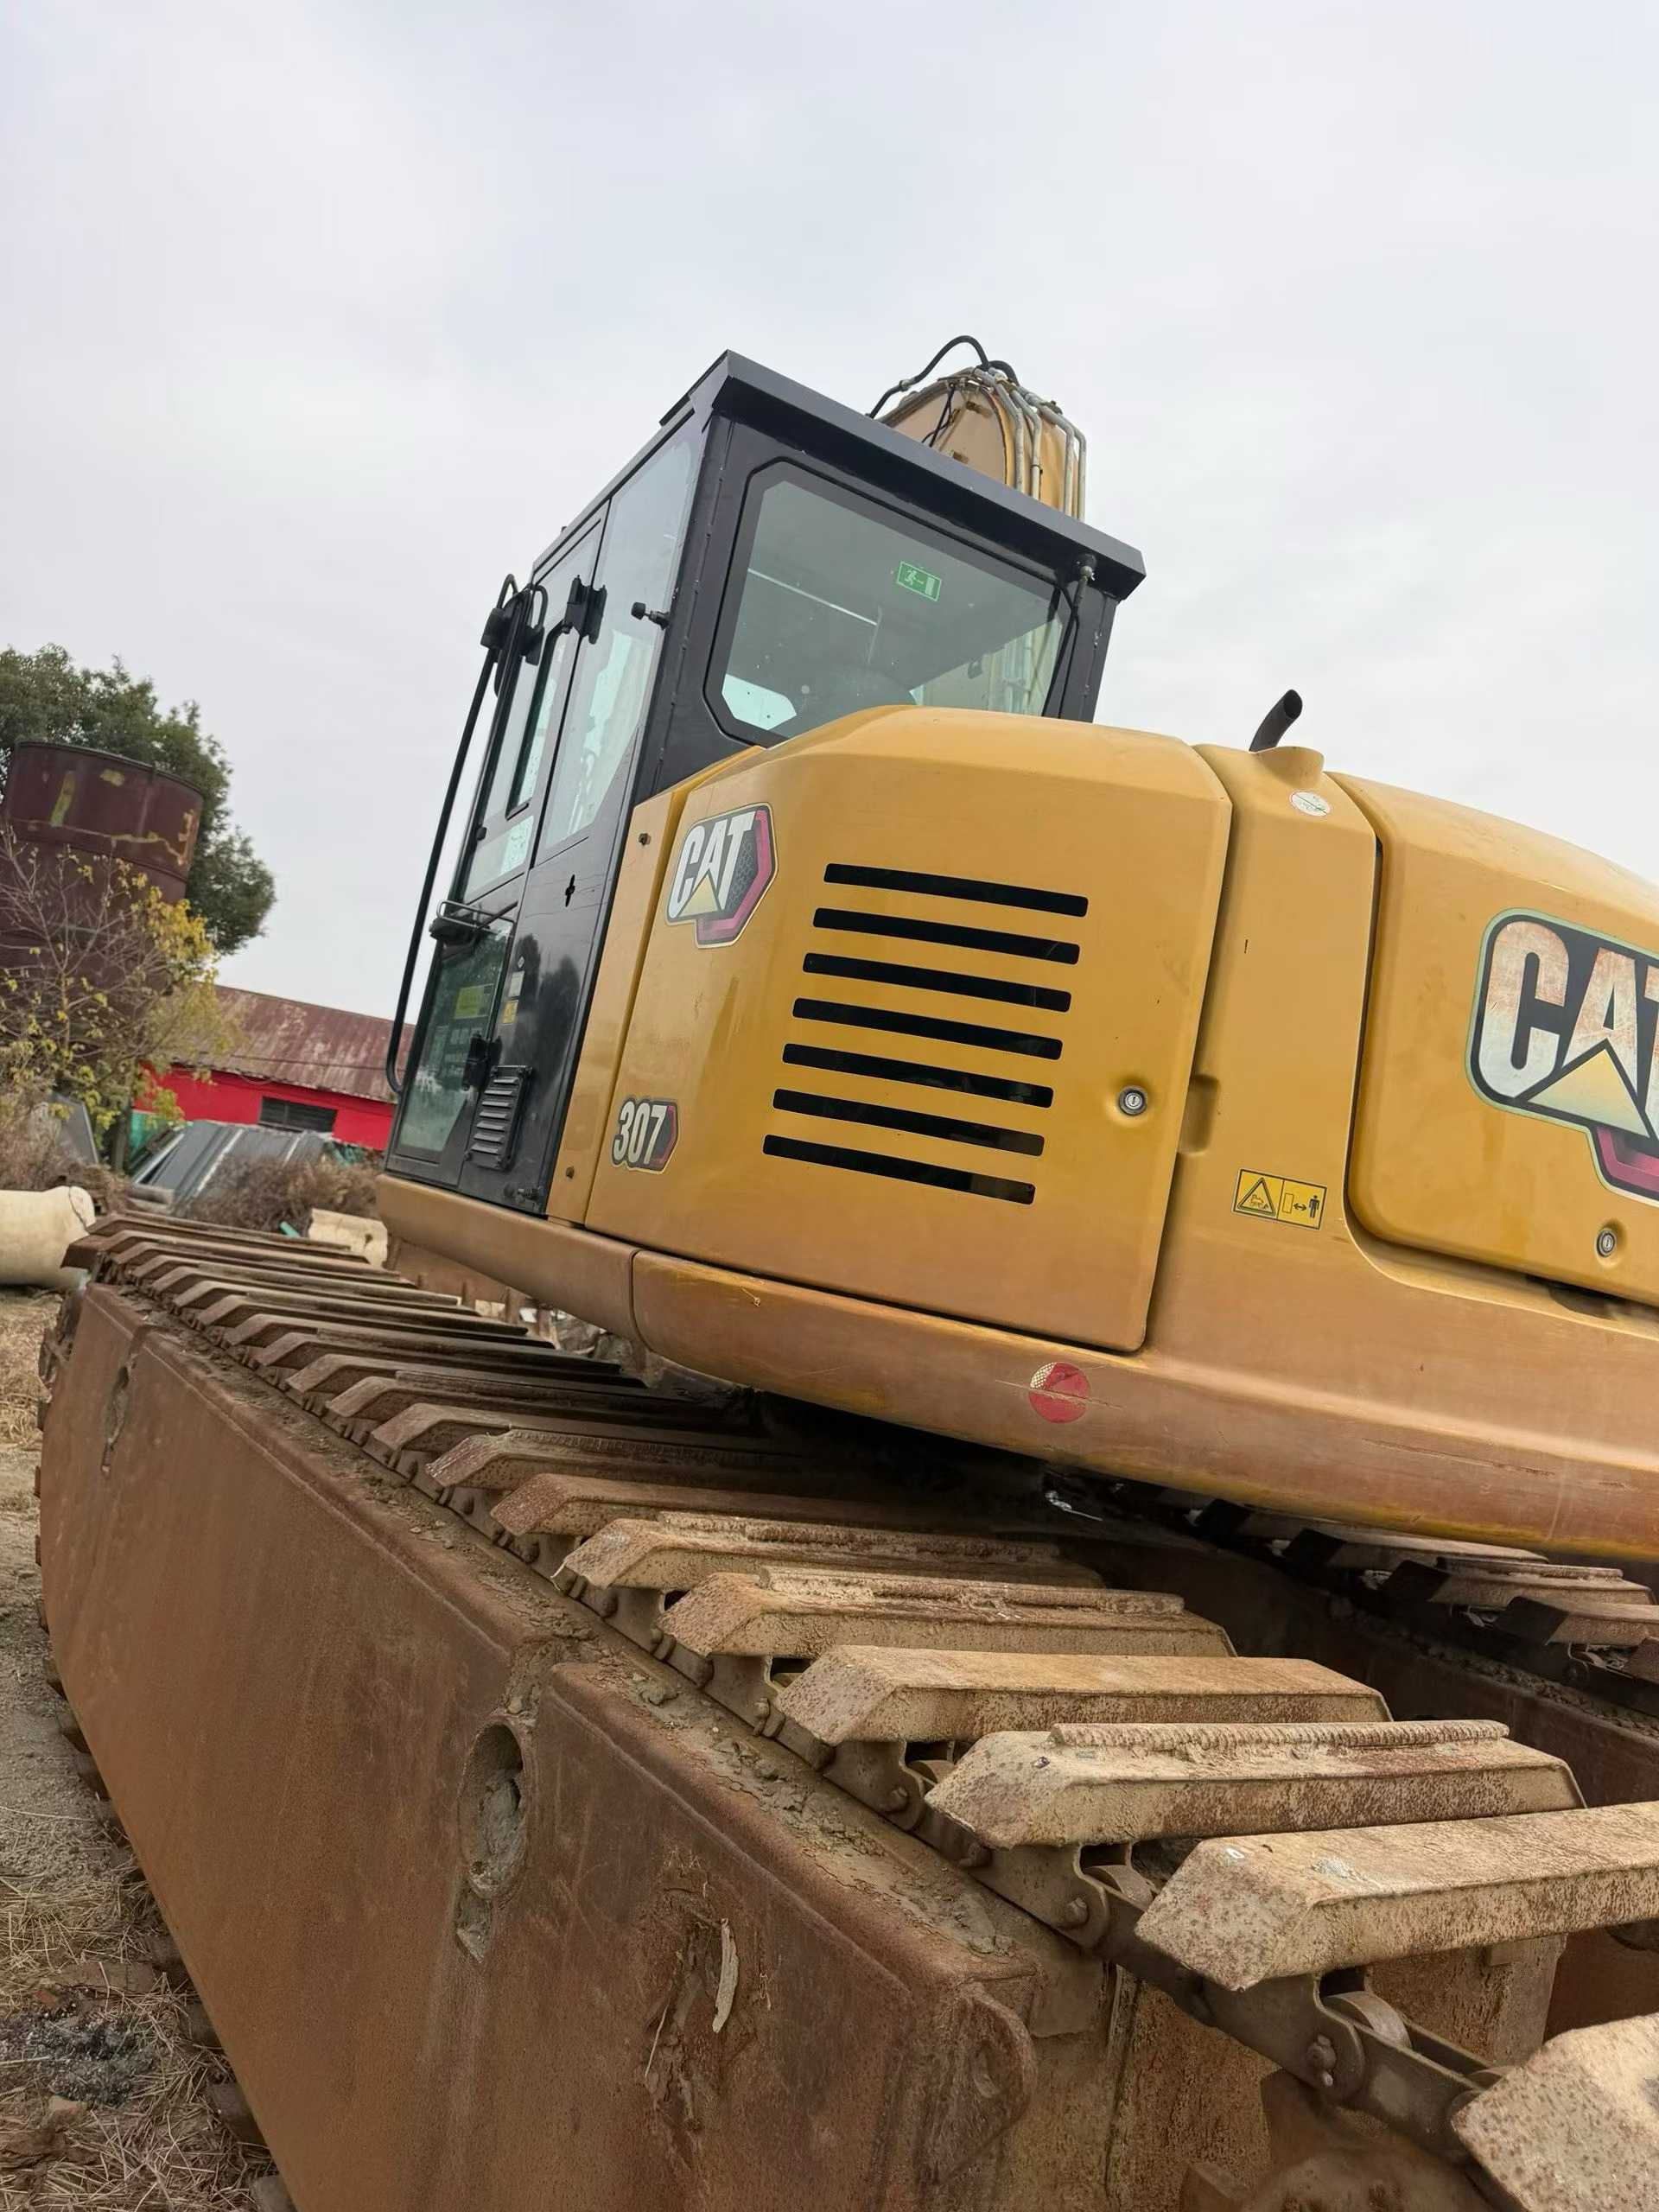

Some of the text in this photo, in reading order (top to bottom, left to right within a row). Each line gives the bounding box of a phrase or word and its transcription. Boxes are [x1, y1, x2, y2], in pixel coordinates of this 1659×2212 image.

[668, 810, 756, 918] CAT
[1478, 920, 1659, 1141] CA
[613, 1100, 668, 1165] 307
